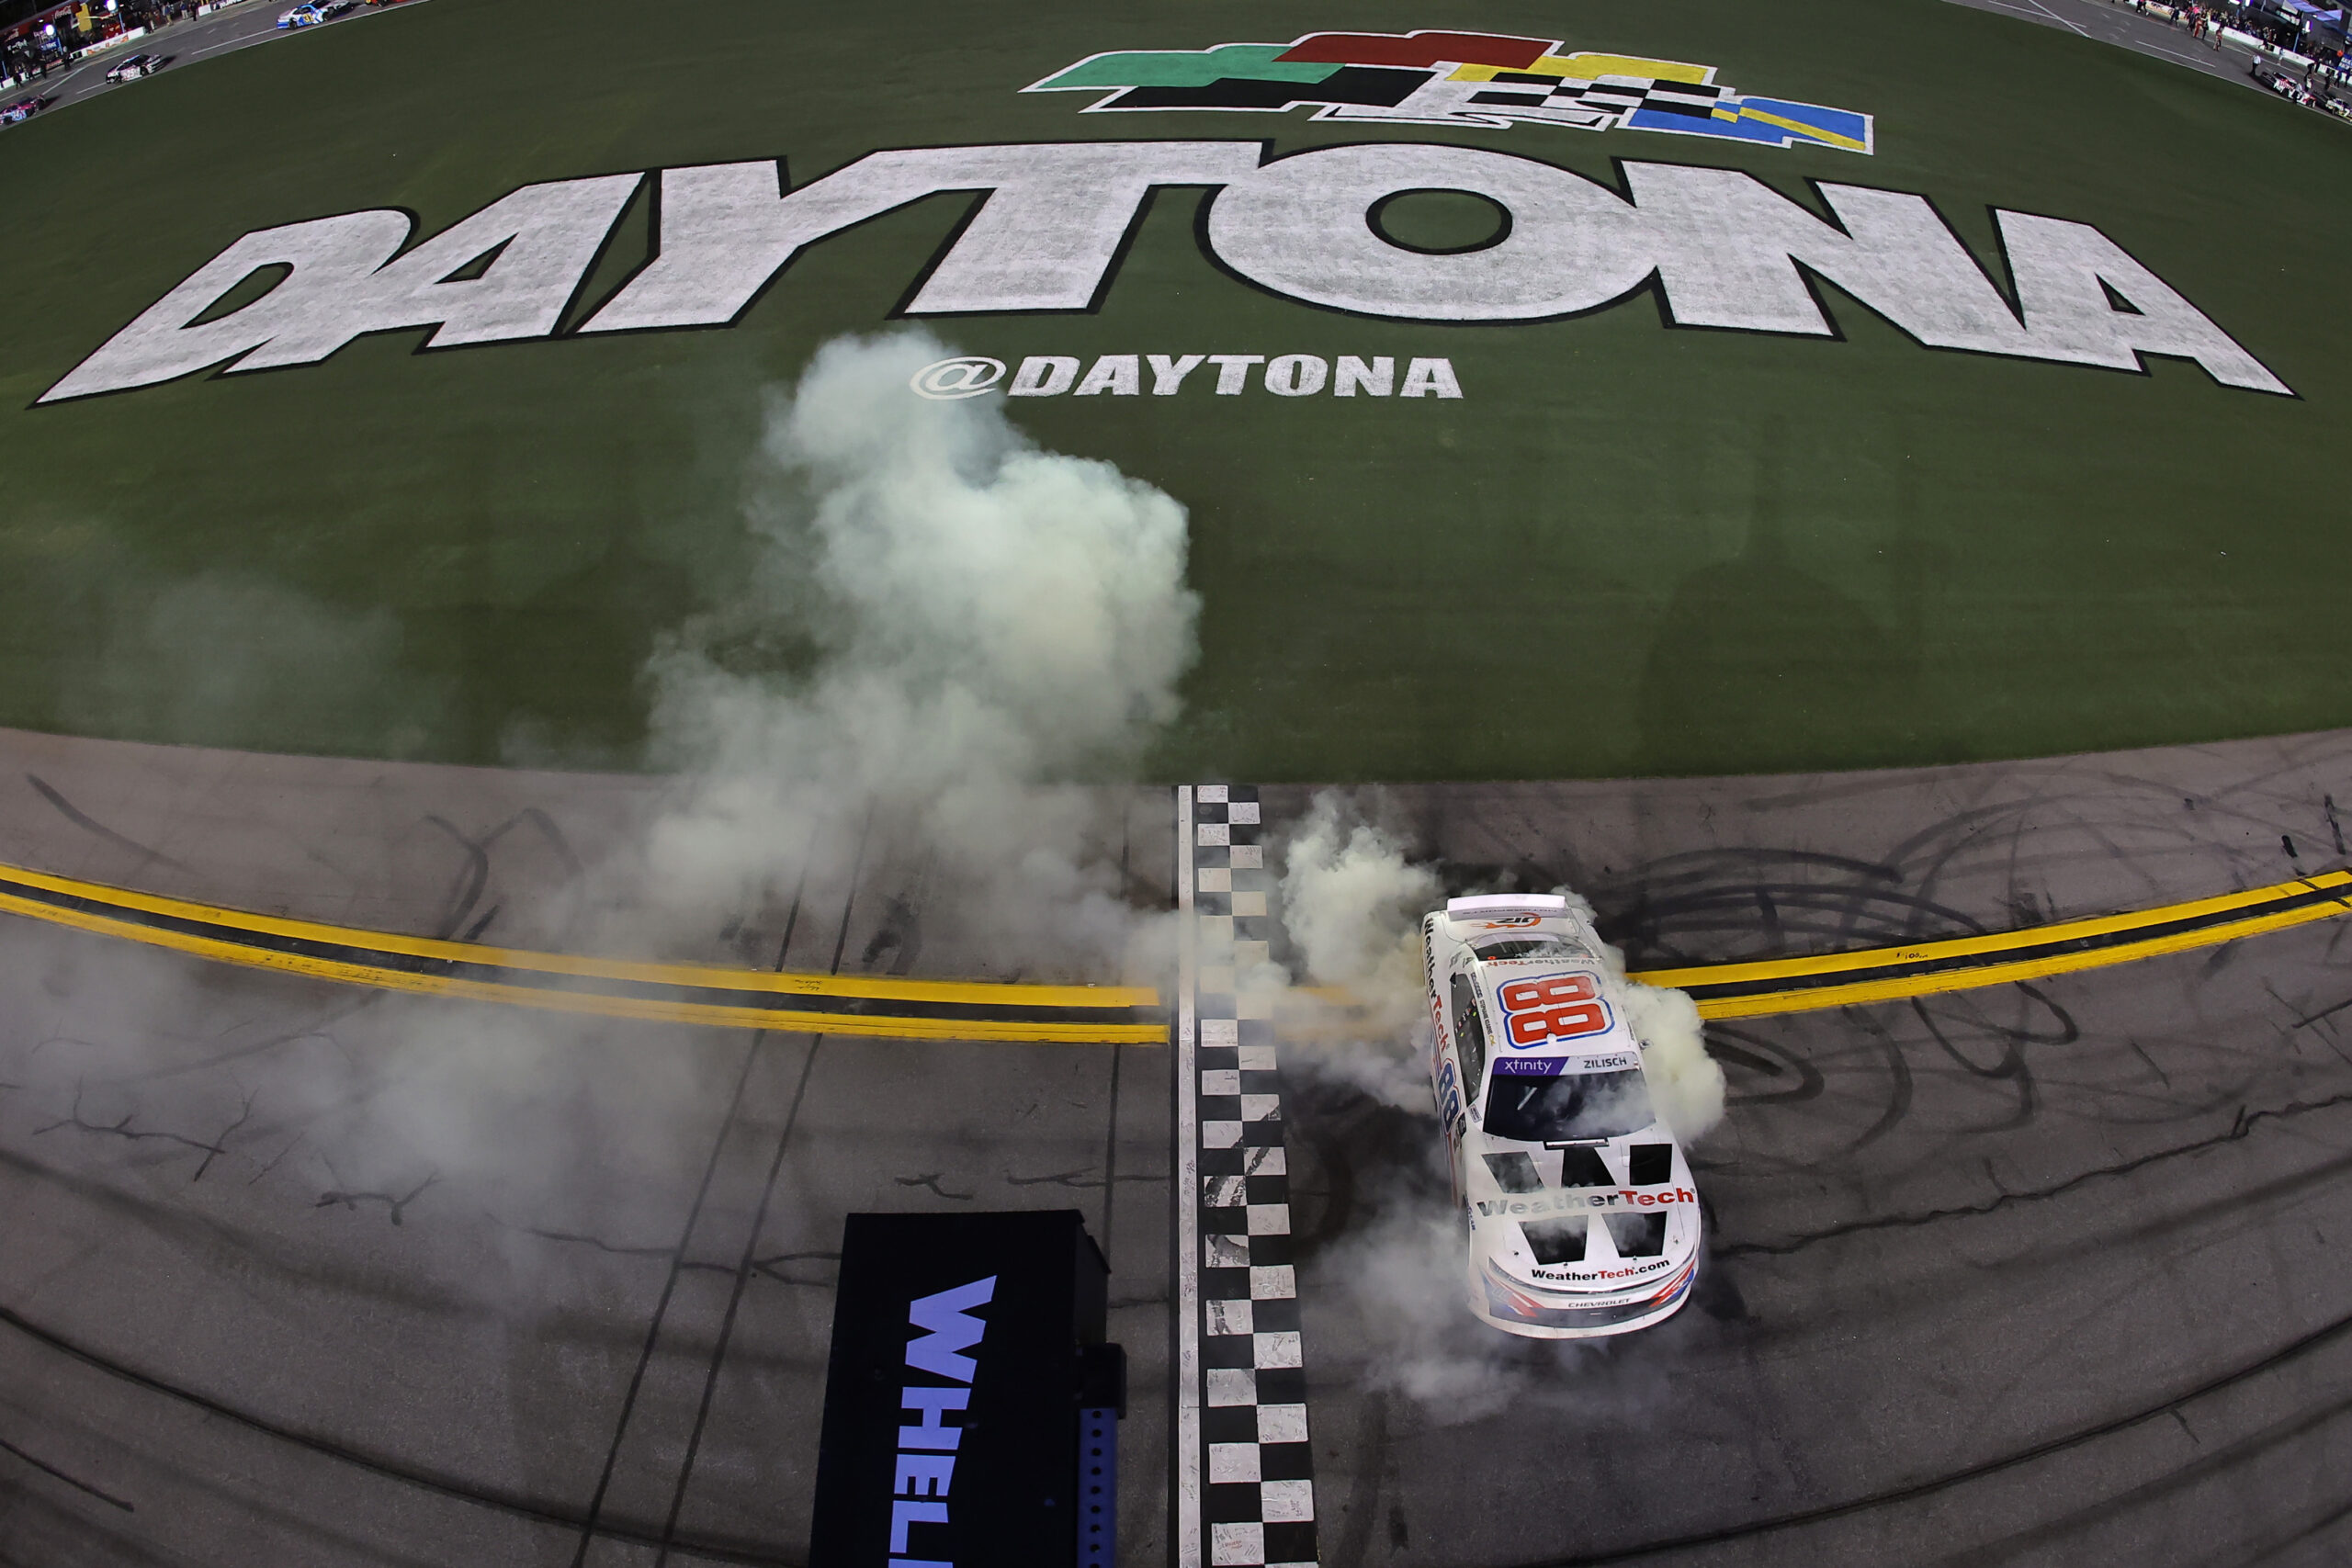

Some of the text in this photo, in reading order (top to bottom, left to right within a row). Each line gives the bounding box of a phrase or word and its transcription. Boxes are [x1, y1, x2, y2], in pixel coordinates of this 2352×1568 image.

[35, 140, 2295, 405] DAYTONA
[909, 354, 1464, 400] @DAYTONA
[1501, 974, 1608, 1045] 88
[1504, 1058, 1553, 1074] xfinity
[1583, 1056, 1627, 1069] ZILISCH
[1567, 1297, 1631, 1308] CHEVROLET
[888, 1274, 998, 1568] WHEL
